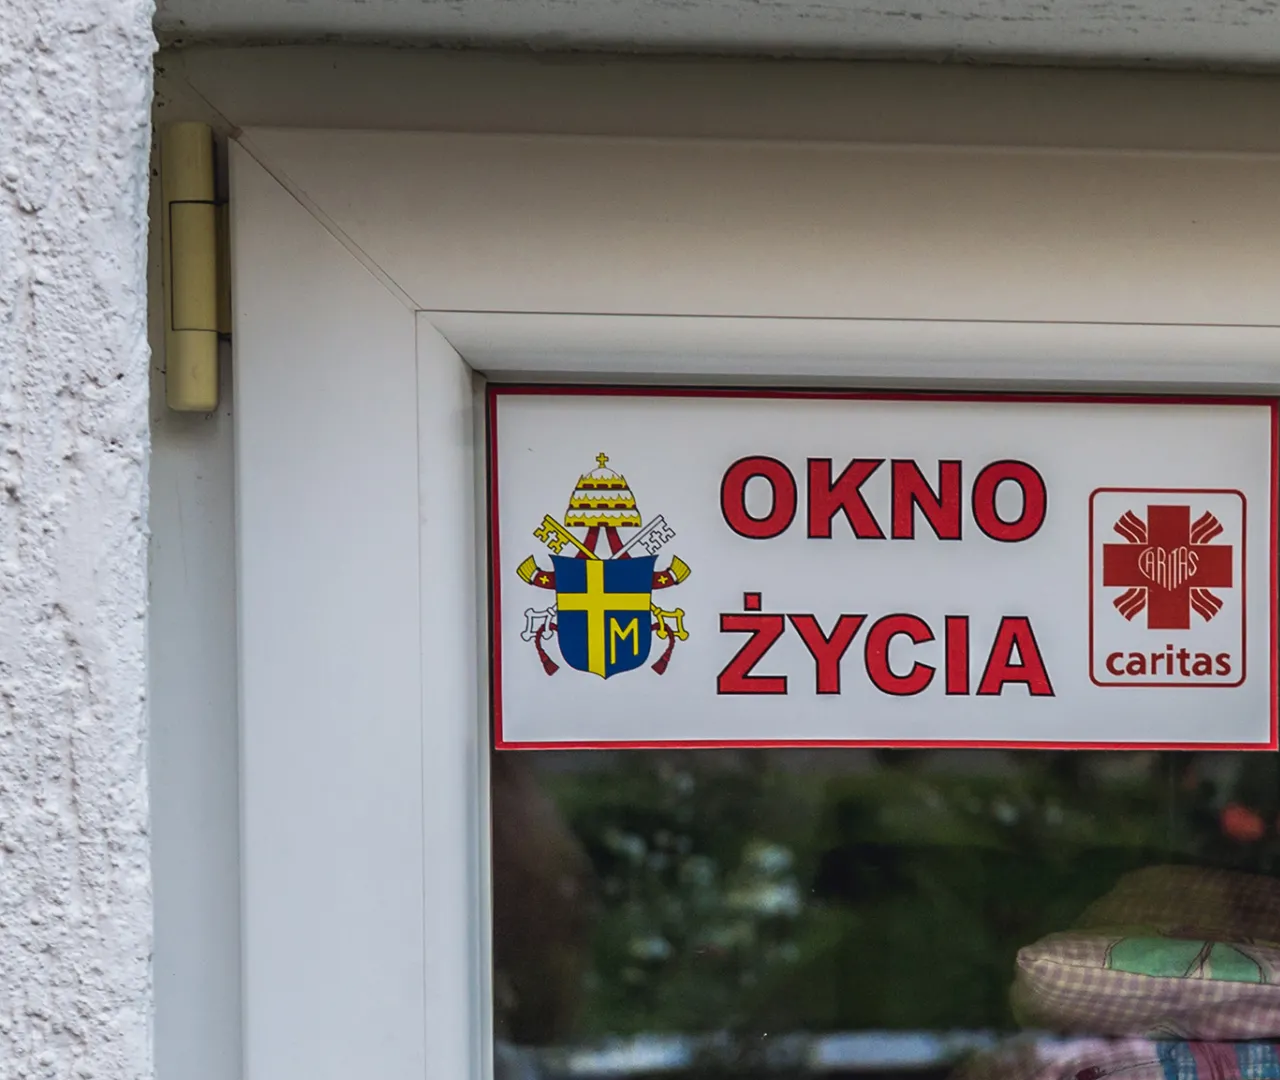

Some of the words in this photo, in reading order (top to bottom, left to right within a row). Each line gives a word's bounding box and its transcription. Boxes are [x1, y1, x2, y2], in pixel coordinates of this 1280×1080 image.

[719, 455, 1048, 544] OKNO
[1137, 545, 1200, 592] CARITAS
[716, 591, 1056, 698] ŻYCIA
[1105, 643, 1232, 677] caritas
